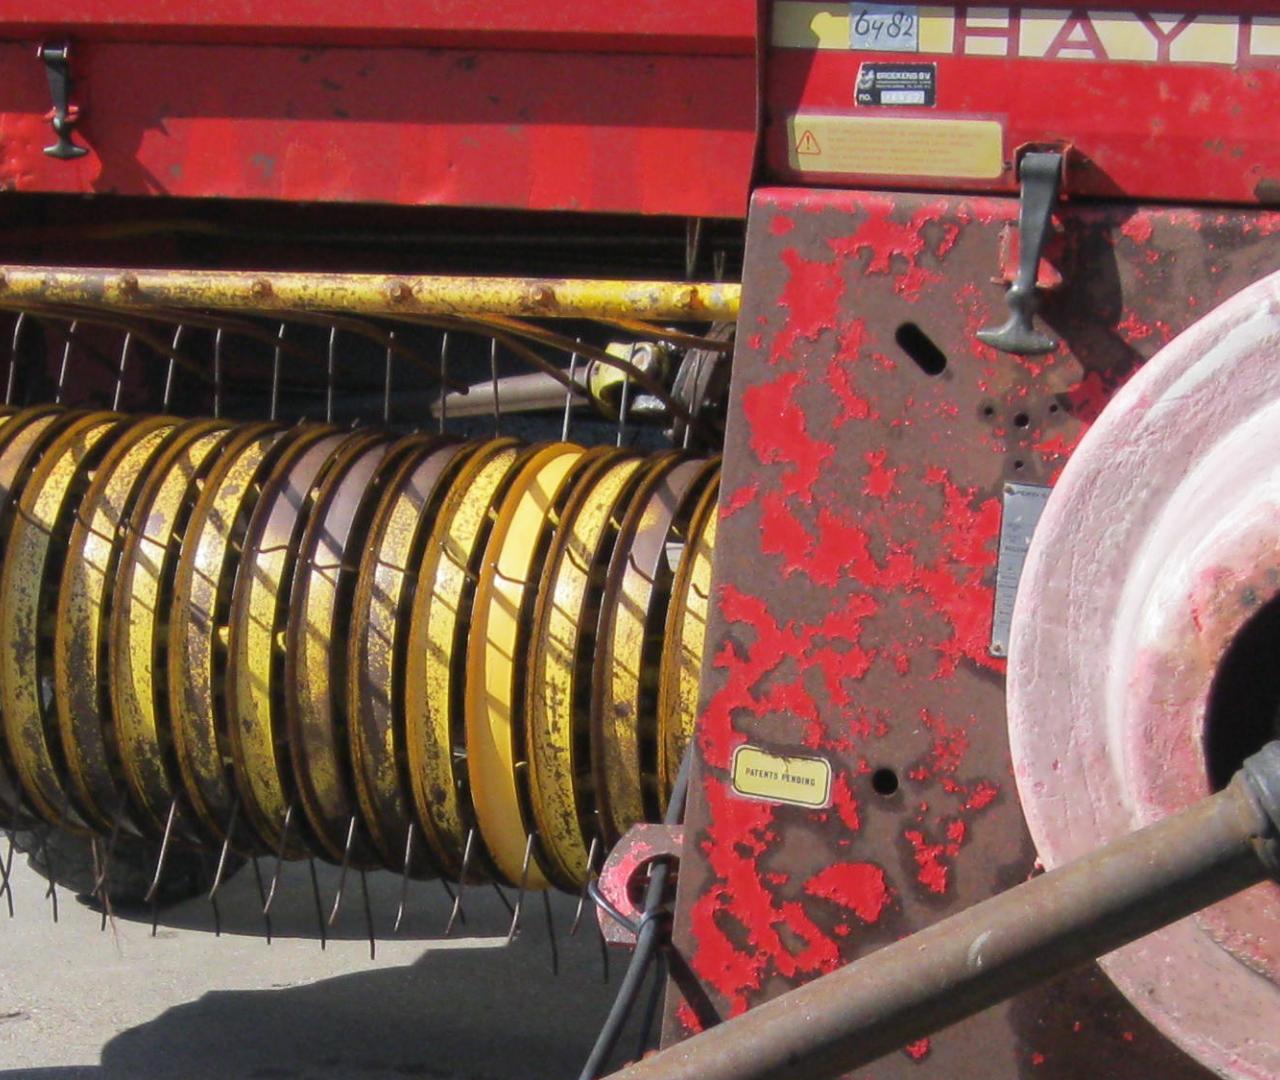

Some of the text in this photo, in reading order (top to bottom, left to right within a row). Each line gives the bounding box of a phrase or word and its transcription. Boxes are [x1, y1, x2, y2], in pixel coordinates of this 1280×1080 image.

[854, 9, 914, 40] 6482
[745, 767, 816, 787] PATENTS PENDING
